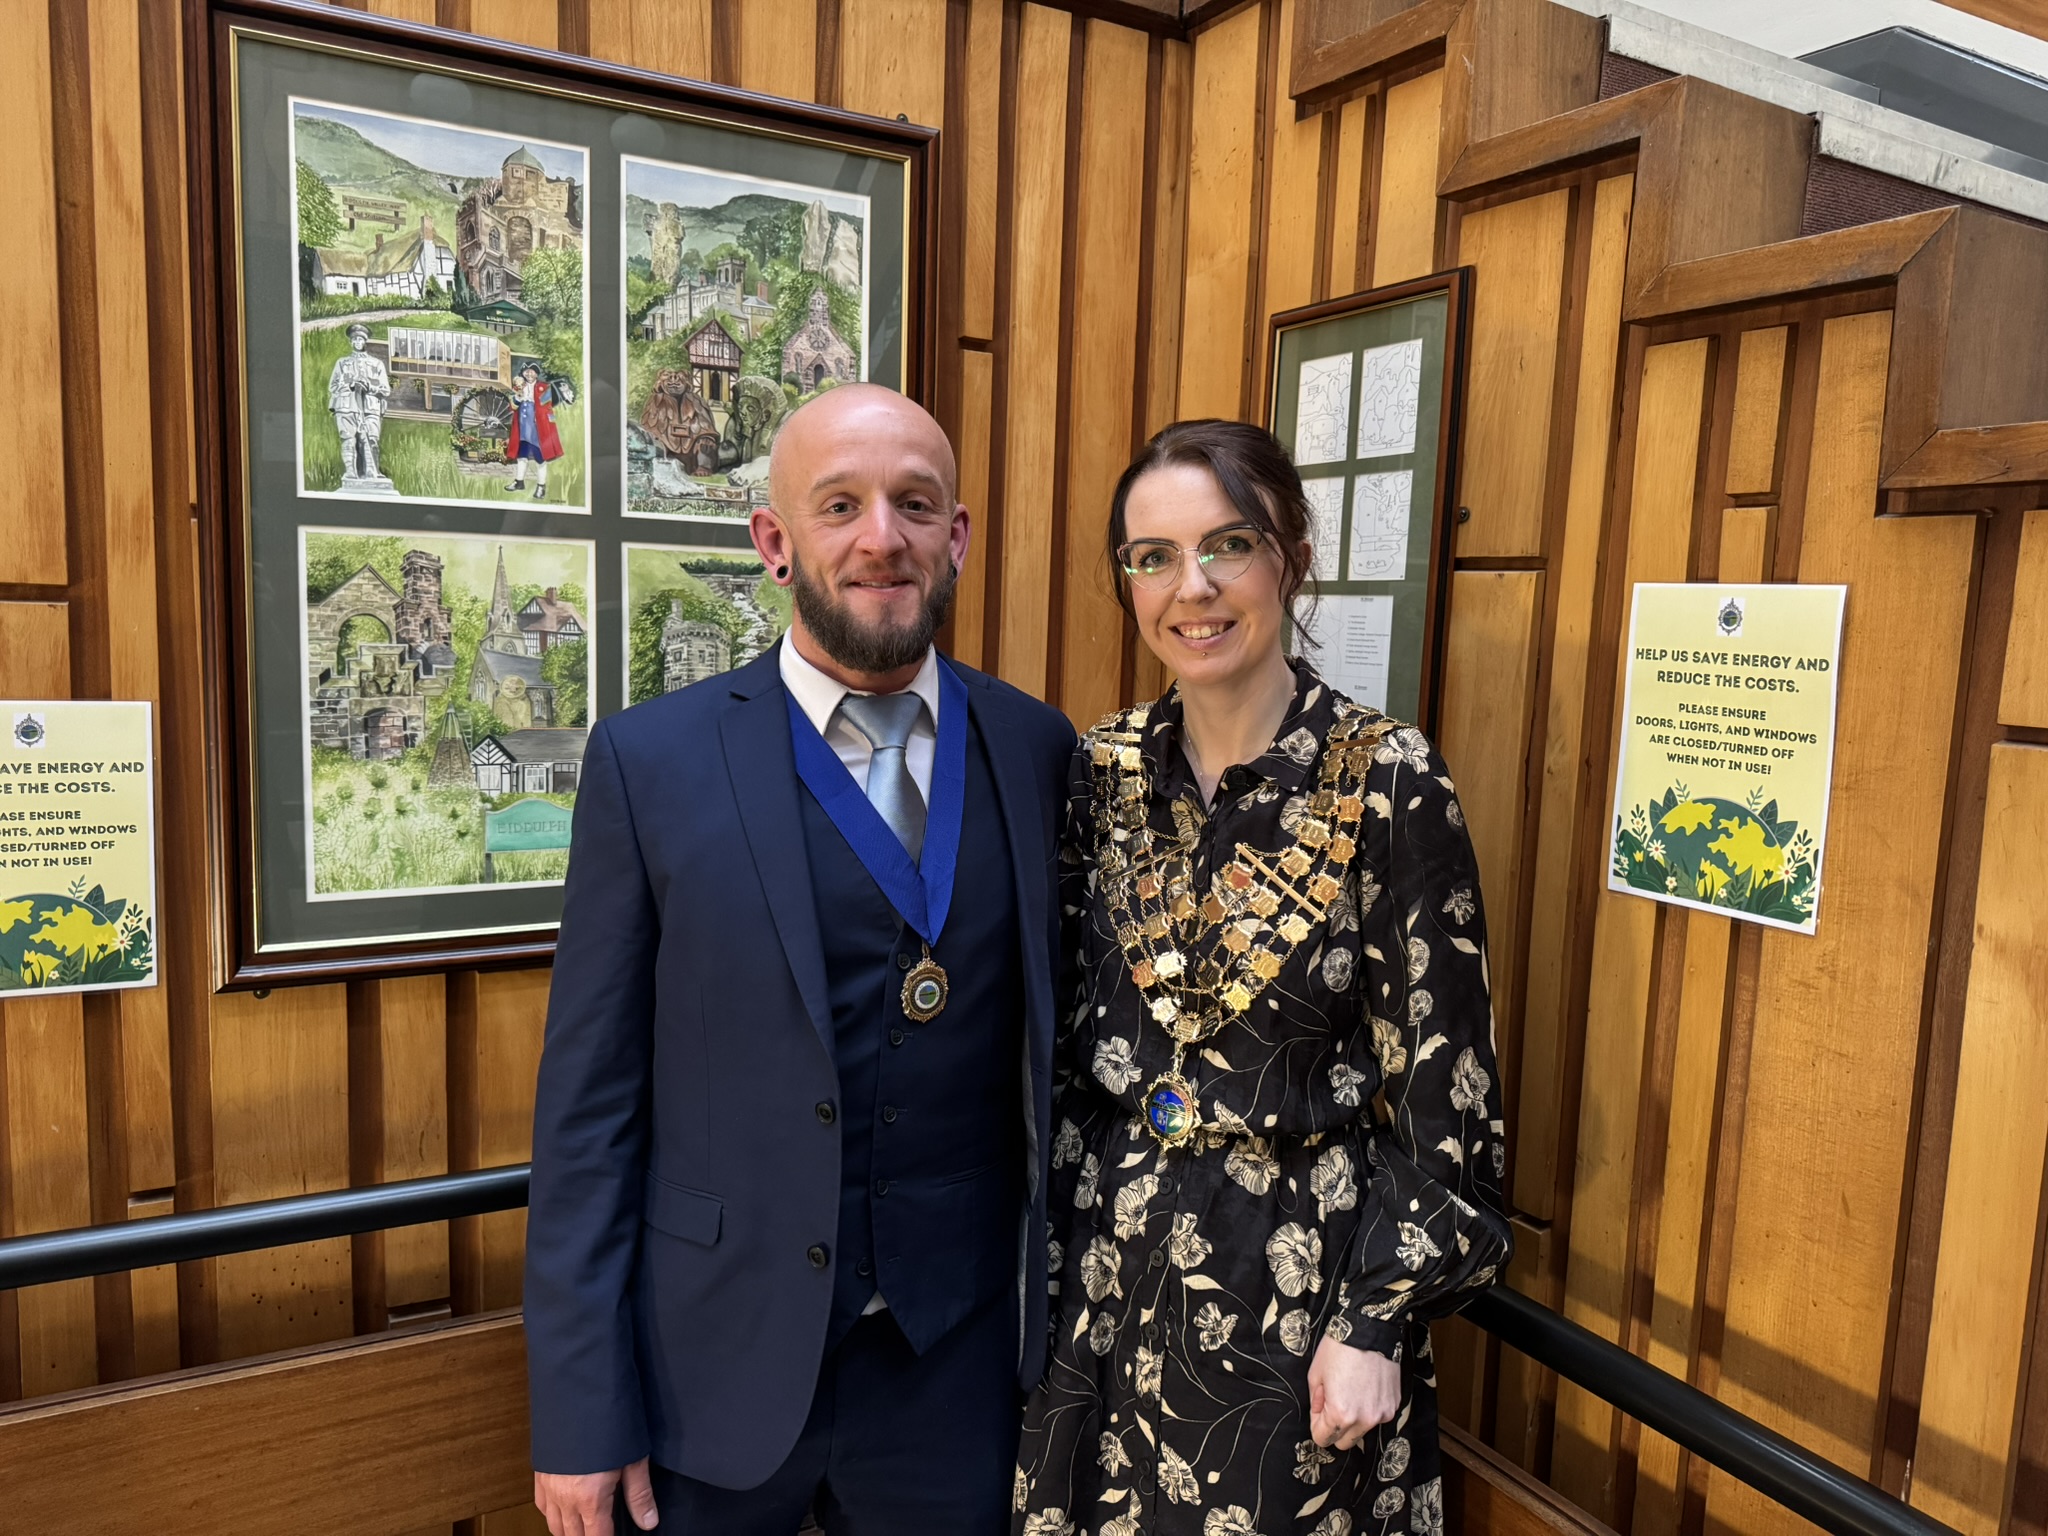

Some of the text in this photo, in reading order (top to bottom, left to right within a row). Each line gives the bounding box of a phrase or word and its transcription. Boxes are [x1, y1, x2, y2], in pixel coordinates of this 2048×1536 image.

[1636, 648, 1830, 672] HELP US SAVE ENERGY AND
[1658, 671, 1799, 693] REDUCE THE COSTS.
[1679, 703, 1766, 720] PLEASE ENSURE
[1636, 716, 1817, 744] DOORS, LIGHTS, AND WINDOWS
[1649, 735, 1794, 759] ARE CLOSED/TURNED OFF
[38, 762, 104, 773] ENERGY
[109, 762, 144, 772] AND
[1667, 752, 1771, 774] WHEN NOT IN USE!
[18, 783, 49, 793] THE
[55, 782, 115, 793] COSTS.
[30, 811, 81, 820] ENSURE
[0, 825, 137, 837] HTS, AND WINDOWS
[91, 840, 115, 849] OFF
[12, 858, 39, 868] NOT
[43, 858, 58, 866] IN
[63, 857, 92, 865] USE!
